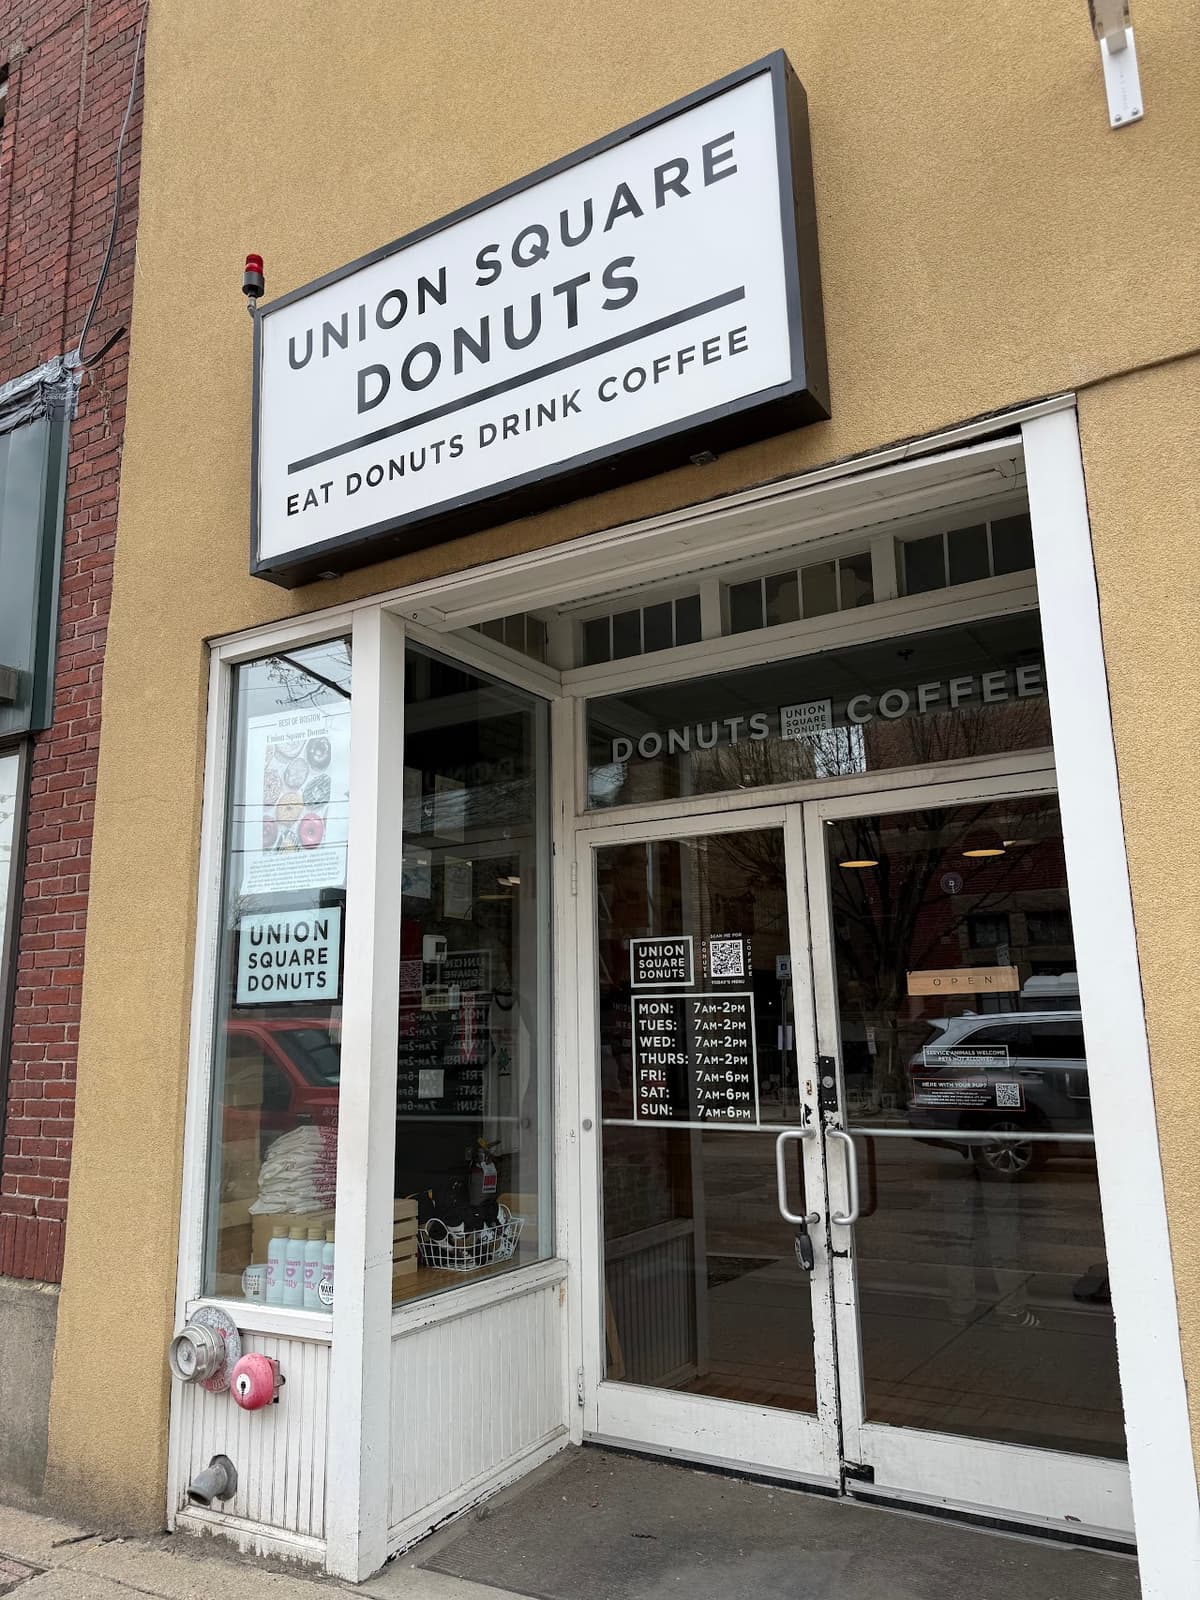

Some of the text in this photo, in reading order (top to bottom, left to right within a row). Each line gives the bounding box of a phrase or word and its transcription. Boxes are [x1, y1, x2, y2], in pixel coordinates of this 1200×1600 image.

[289, 131, 738, 370] UNION SQUARE
[357, 256, 638, 414] DONUTS
[287, 326, 749, 516] EAT DONUTS DRINK COFFEE
[612, 667, 1043, 763] DONUTS COFFEE
[786, 705, 825, 719] UNION
[786, 714, 827, 728] SQUARE
[787, 723, 827, 736] DONUTS
[248, 920, 329, 947] UNION
[639, 945, 685, 958] UNION
[247, 948, 328, 970] SQUARE
[639, 958, 685, 968] SQUARE
[639, 968, 685, 979] DONUTS
[247, 970, 327, 992] DONUTS
[933, 976, 993, 986] OPEN
[639, 1002, 746, 1014] MON: 7AM-2PM
[639, 1018, 747, 1031] TUES: 7AM-2PM
[640, 1035, 748, 1048] WED: 7AM-2PM
[640, 1052, 749, 1065] THURS: 7AM-2PM
[640, 1069, 750, 1083] FRI: 7AM-6PM
[641, 1086, 750, 1100] SAT: 7AM-6PM
[641, 1103, 751, 1118] SUN: 7AM-6PM
